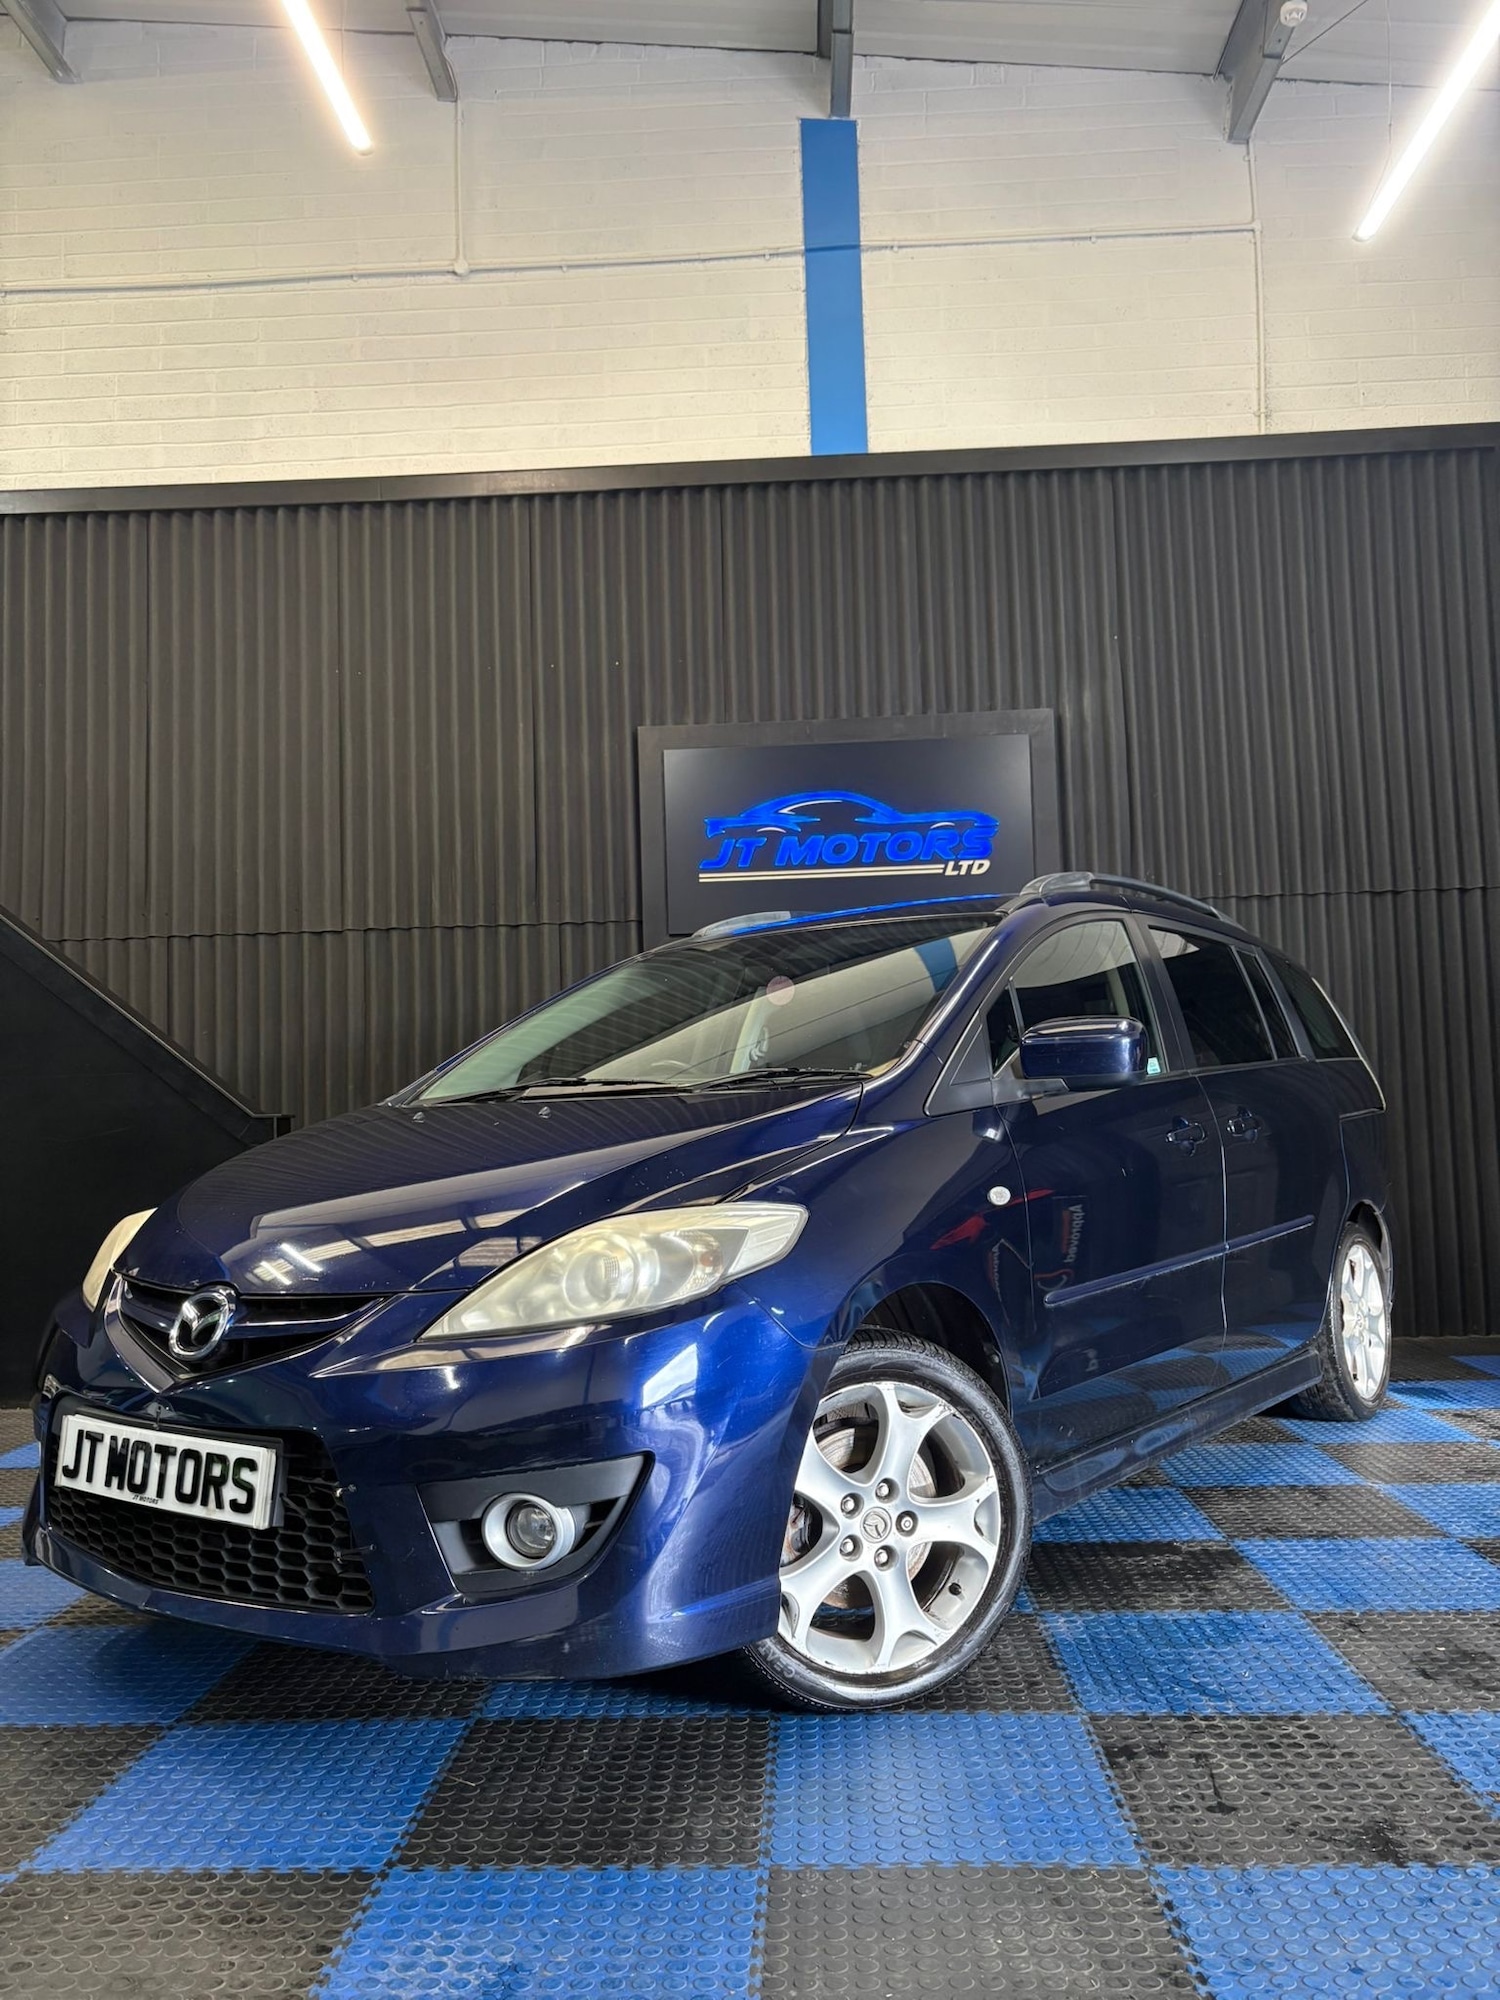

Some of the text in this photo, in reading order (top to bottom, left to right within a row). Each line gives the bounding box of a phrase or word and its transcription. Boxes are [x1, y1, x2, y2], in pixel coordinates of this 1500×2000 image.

[699, 825, 999, 869] JT MOTORS
[944, 859, 991, 876] LTD
[62, 1429, 259, 1515] JT MOTORS
[139, 1495, 159, 1505] MOTORS
